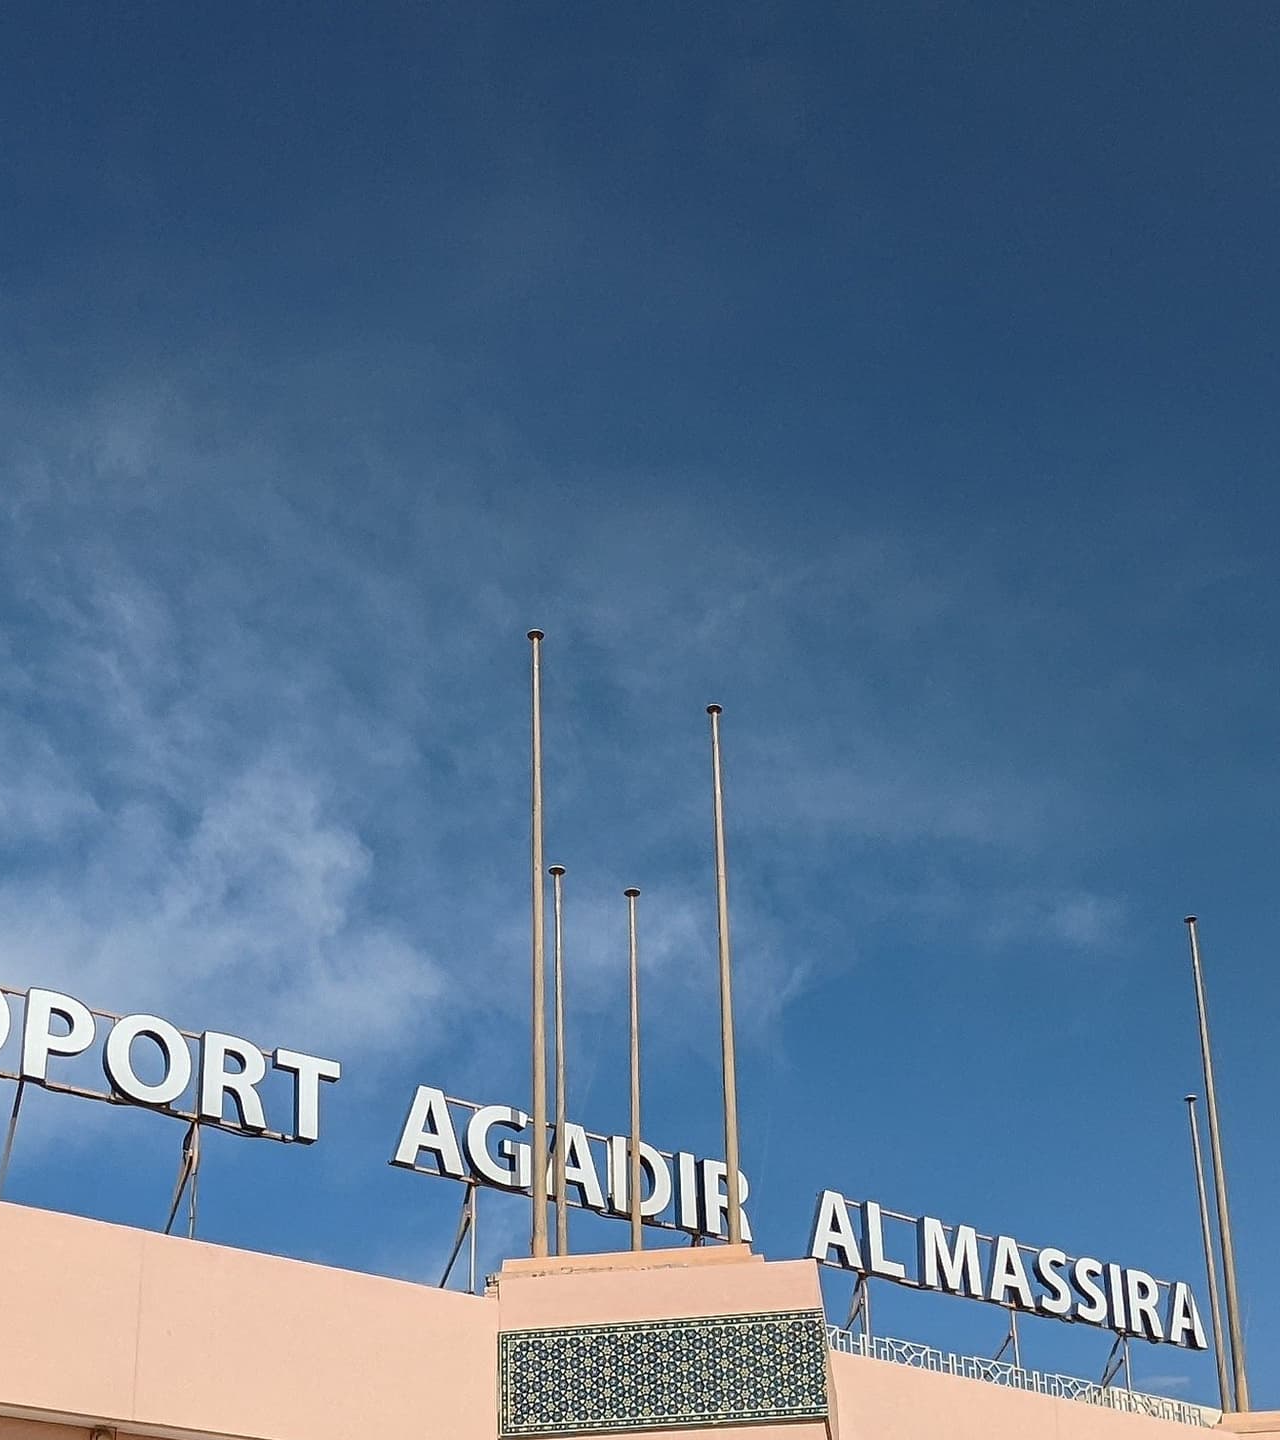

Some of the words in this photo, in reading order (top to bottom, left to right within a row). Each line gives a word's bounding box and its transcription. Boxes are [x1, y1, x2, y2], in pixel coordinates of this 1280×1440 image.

[389, 1085, 753, 1242] AGADIR
[809, 1189, 906, 1278] AL
[919, 1215, 1209, 1350] MASSIRA
